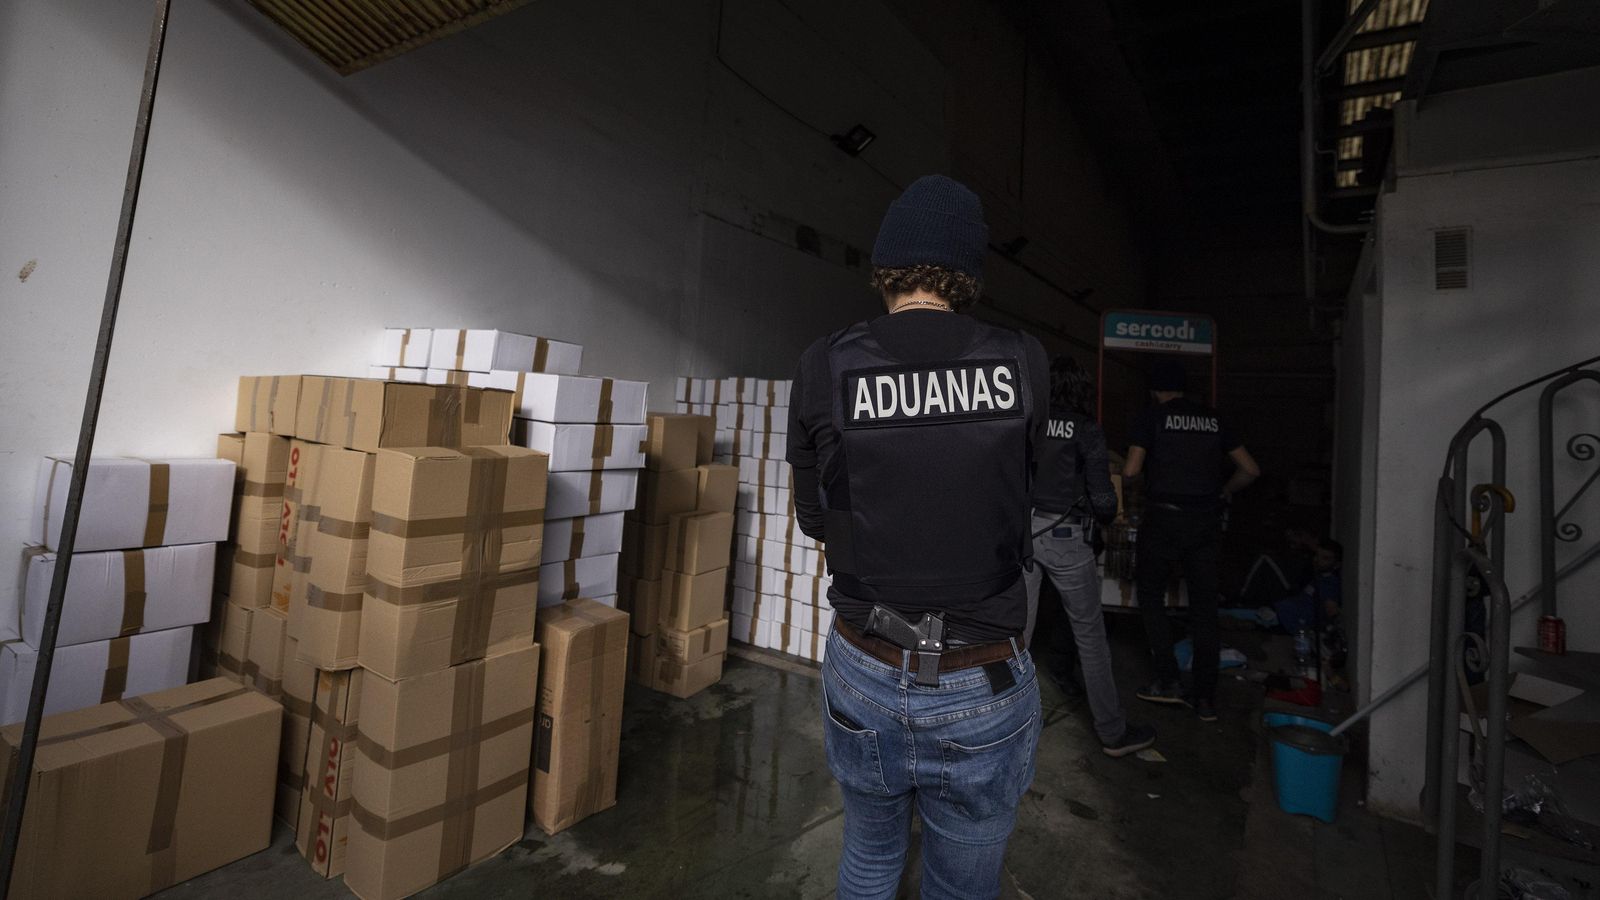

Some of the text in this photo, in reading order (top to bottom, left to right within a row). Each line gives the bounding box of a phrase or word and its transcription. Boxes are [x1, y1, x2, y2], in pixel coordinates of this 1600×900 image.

[1115, 319, 1195, 341] sercodi
[853, 365, 1015, 420] ADUANAS
[1164, 414, 1219, 433] ADUANAS
